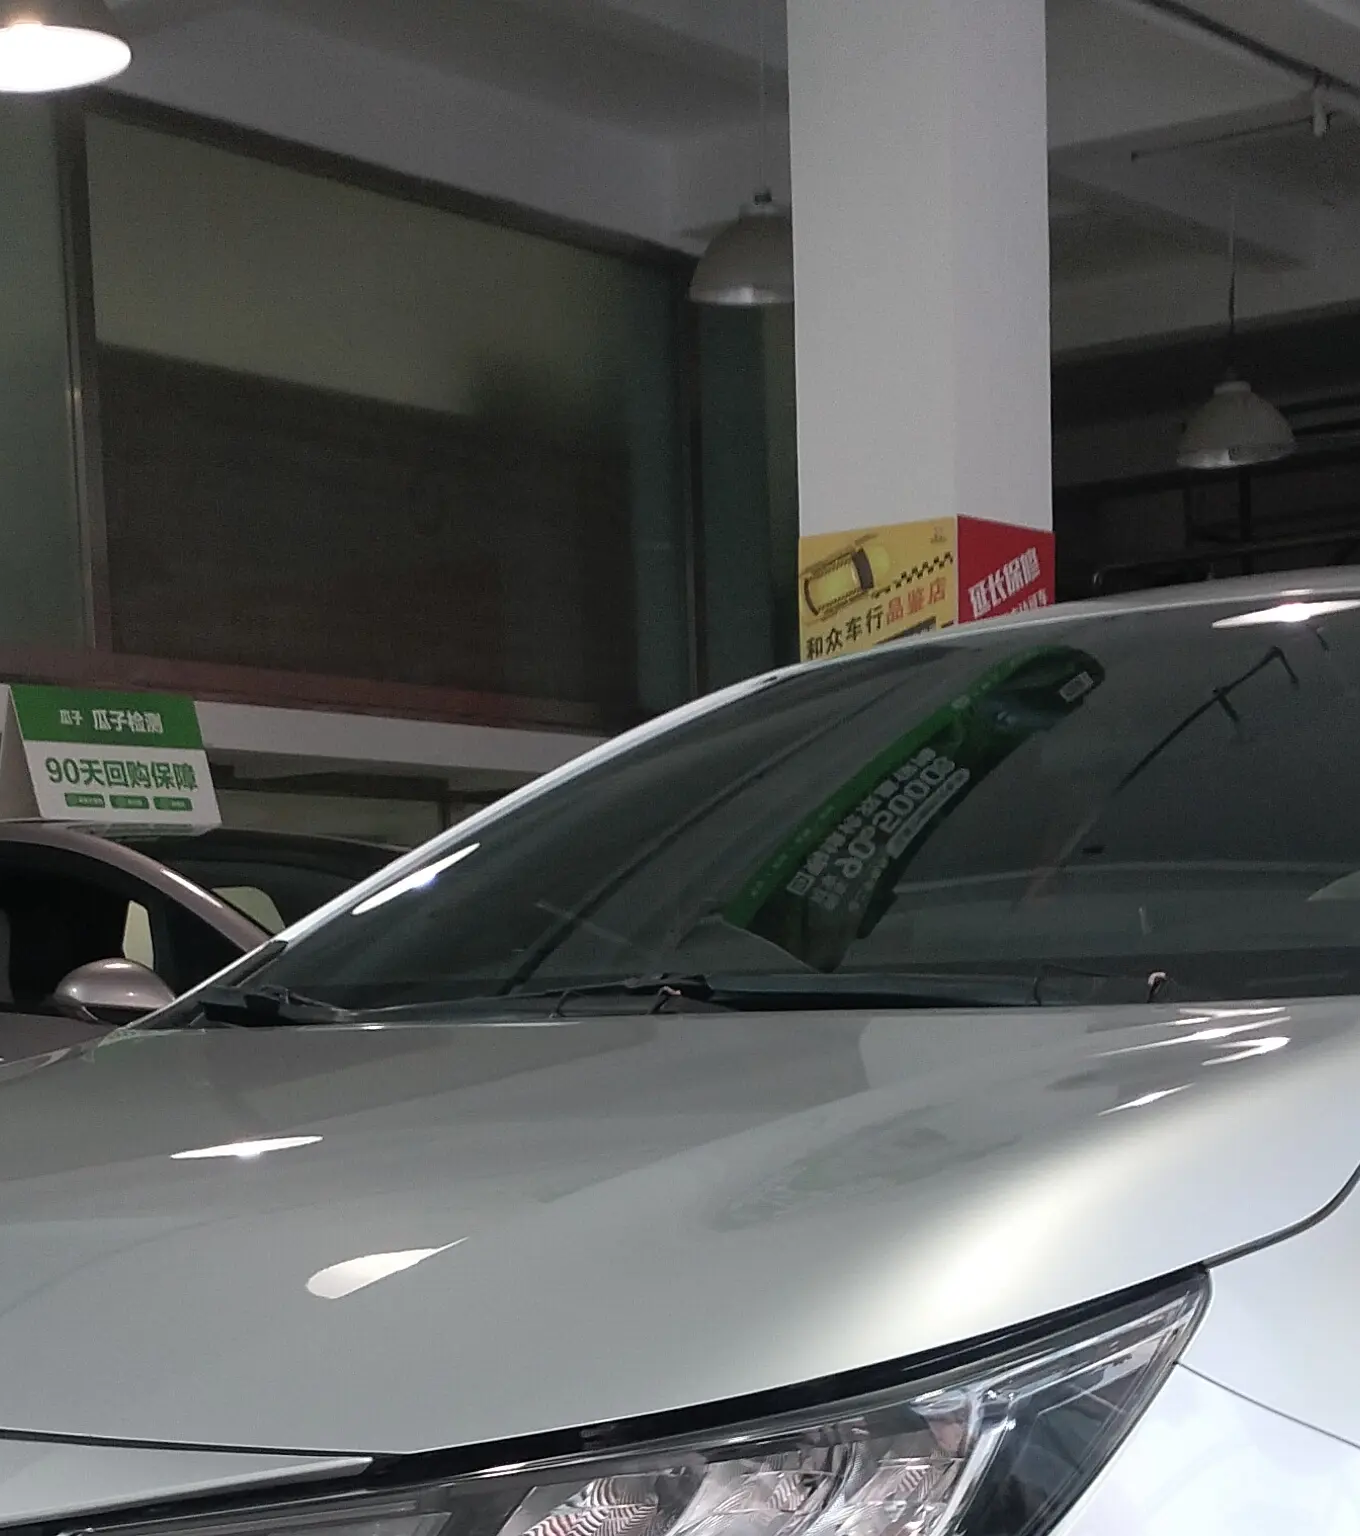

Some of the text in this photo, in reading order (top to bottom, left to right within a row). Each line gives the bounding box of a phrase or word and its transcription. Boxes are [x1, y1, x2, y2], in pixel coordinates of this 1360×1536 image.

[59, 708, 164, 734] 瓜子 瓜子检测
[44, 757, 200, 792] 90天回购保障
